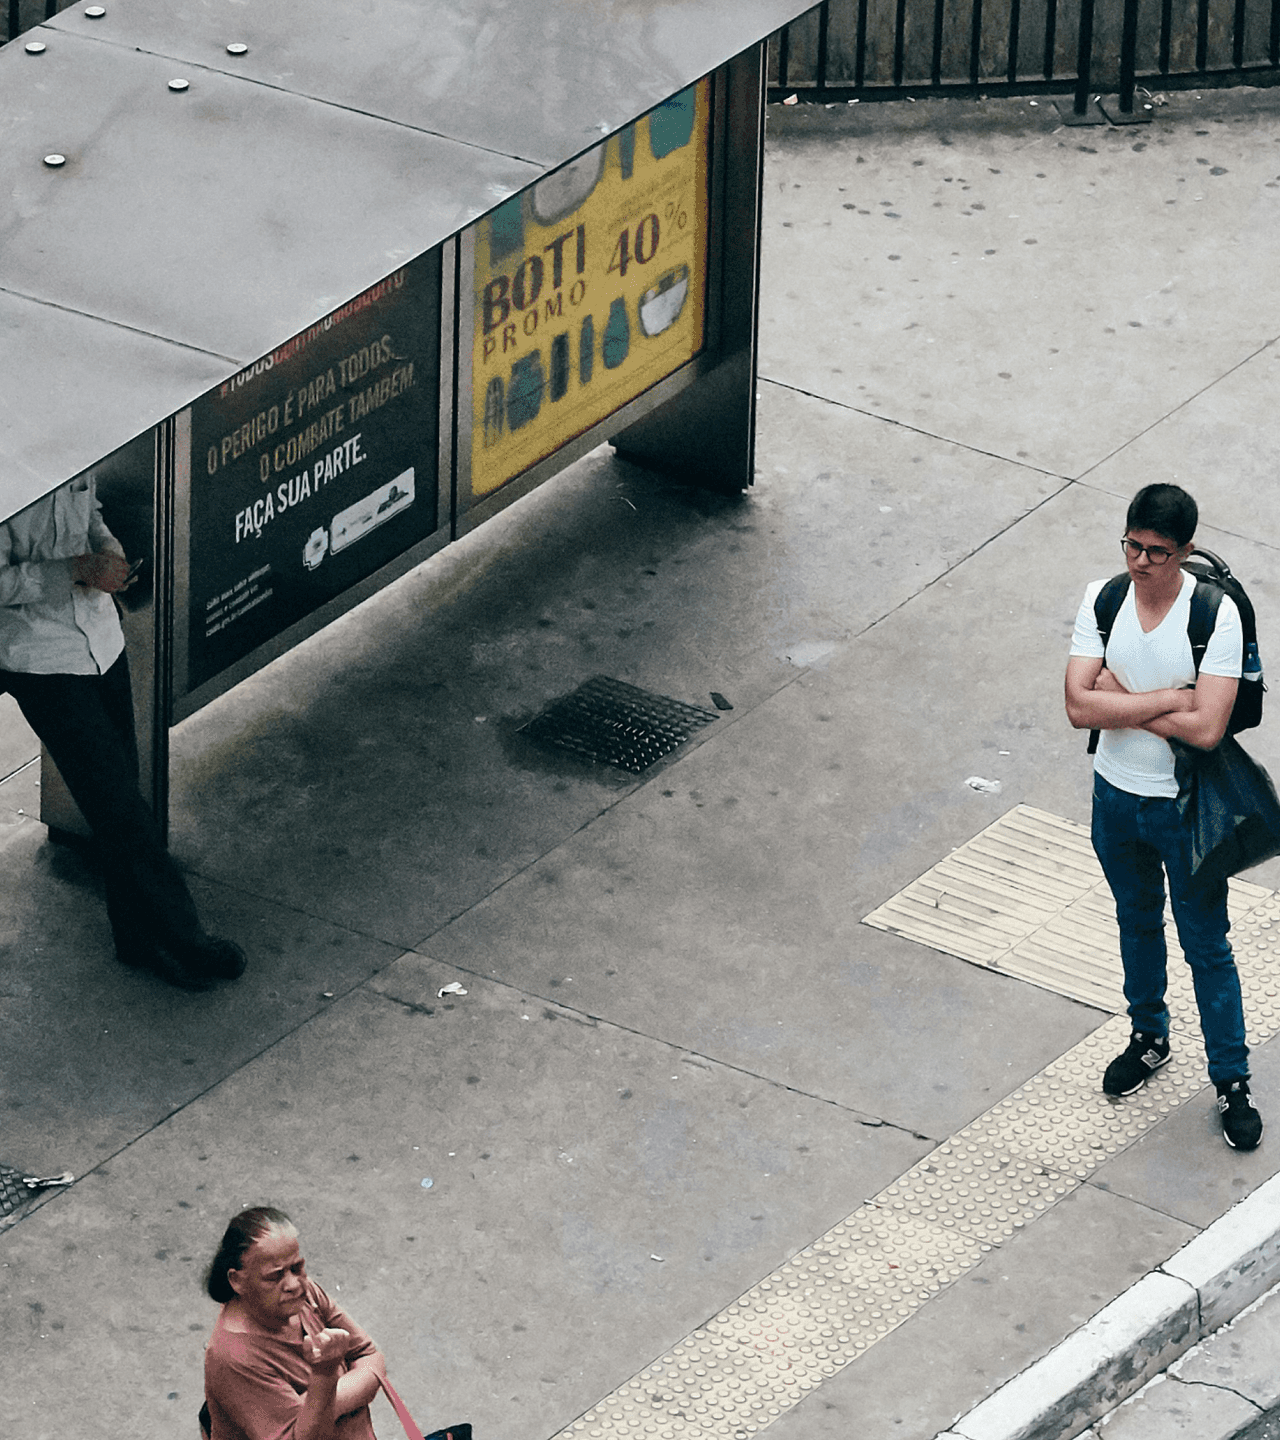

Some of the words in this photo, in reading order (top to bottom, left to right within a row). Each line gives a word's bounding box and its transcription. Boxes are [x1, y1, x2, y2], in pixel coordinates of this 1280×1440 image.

[482, 223, 585, 336] BOTI
[483, 279, 586, 364] PROMO
[207, 446, 218, 475] O
[221, 405, 279, 466] PERIGO
[284, 390, 294, 427] É
[297, 368, 336, 418] PARA
[259, 453, 270, 483] O
[274, 404, 345, 473] COMBATE
[235, 492, 275, 543] FAÇA
[277, 470, 311, 514] SUA
[314, 432, 367, 492] PARTE.
